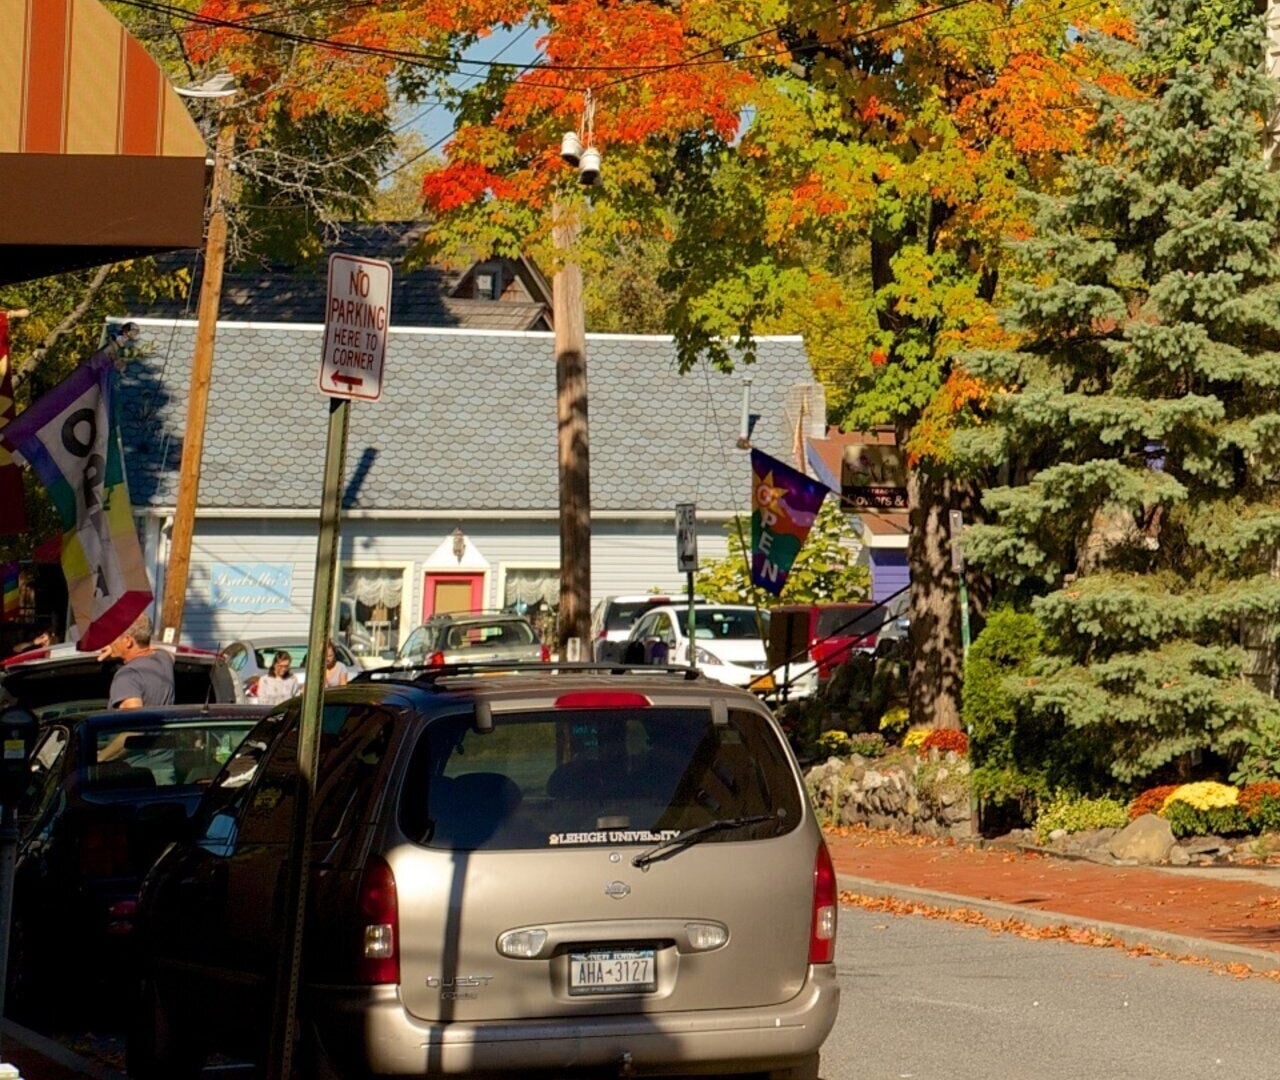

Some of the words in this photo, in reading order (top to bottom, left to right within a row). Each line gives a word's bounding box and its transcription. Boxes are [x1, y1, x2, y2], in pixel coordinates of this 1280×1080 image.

[348, 271, 370, 298] NO
[331, 298, 386, 331] PARKING
[333, 327, 360, 349] HERE
[366, 333, 378, 351] TO
[332, 348, 375, 371] CORNER
[558, 831, 608, 844] LEHIGH
[609, 830, 681, 843] UNIVERSITY
[578, 962, 604, 984] AHA
[614, 961, 649, 983] 3127
